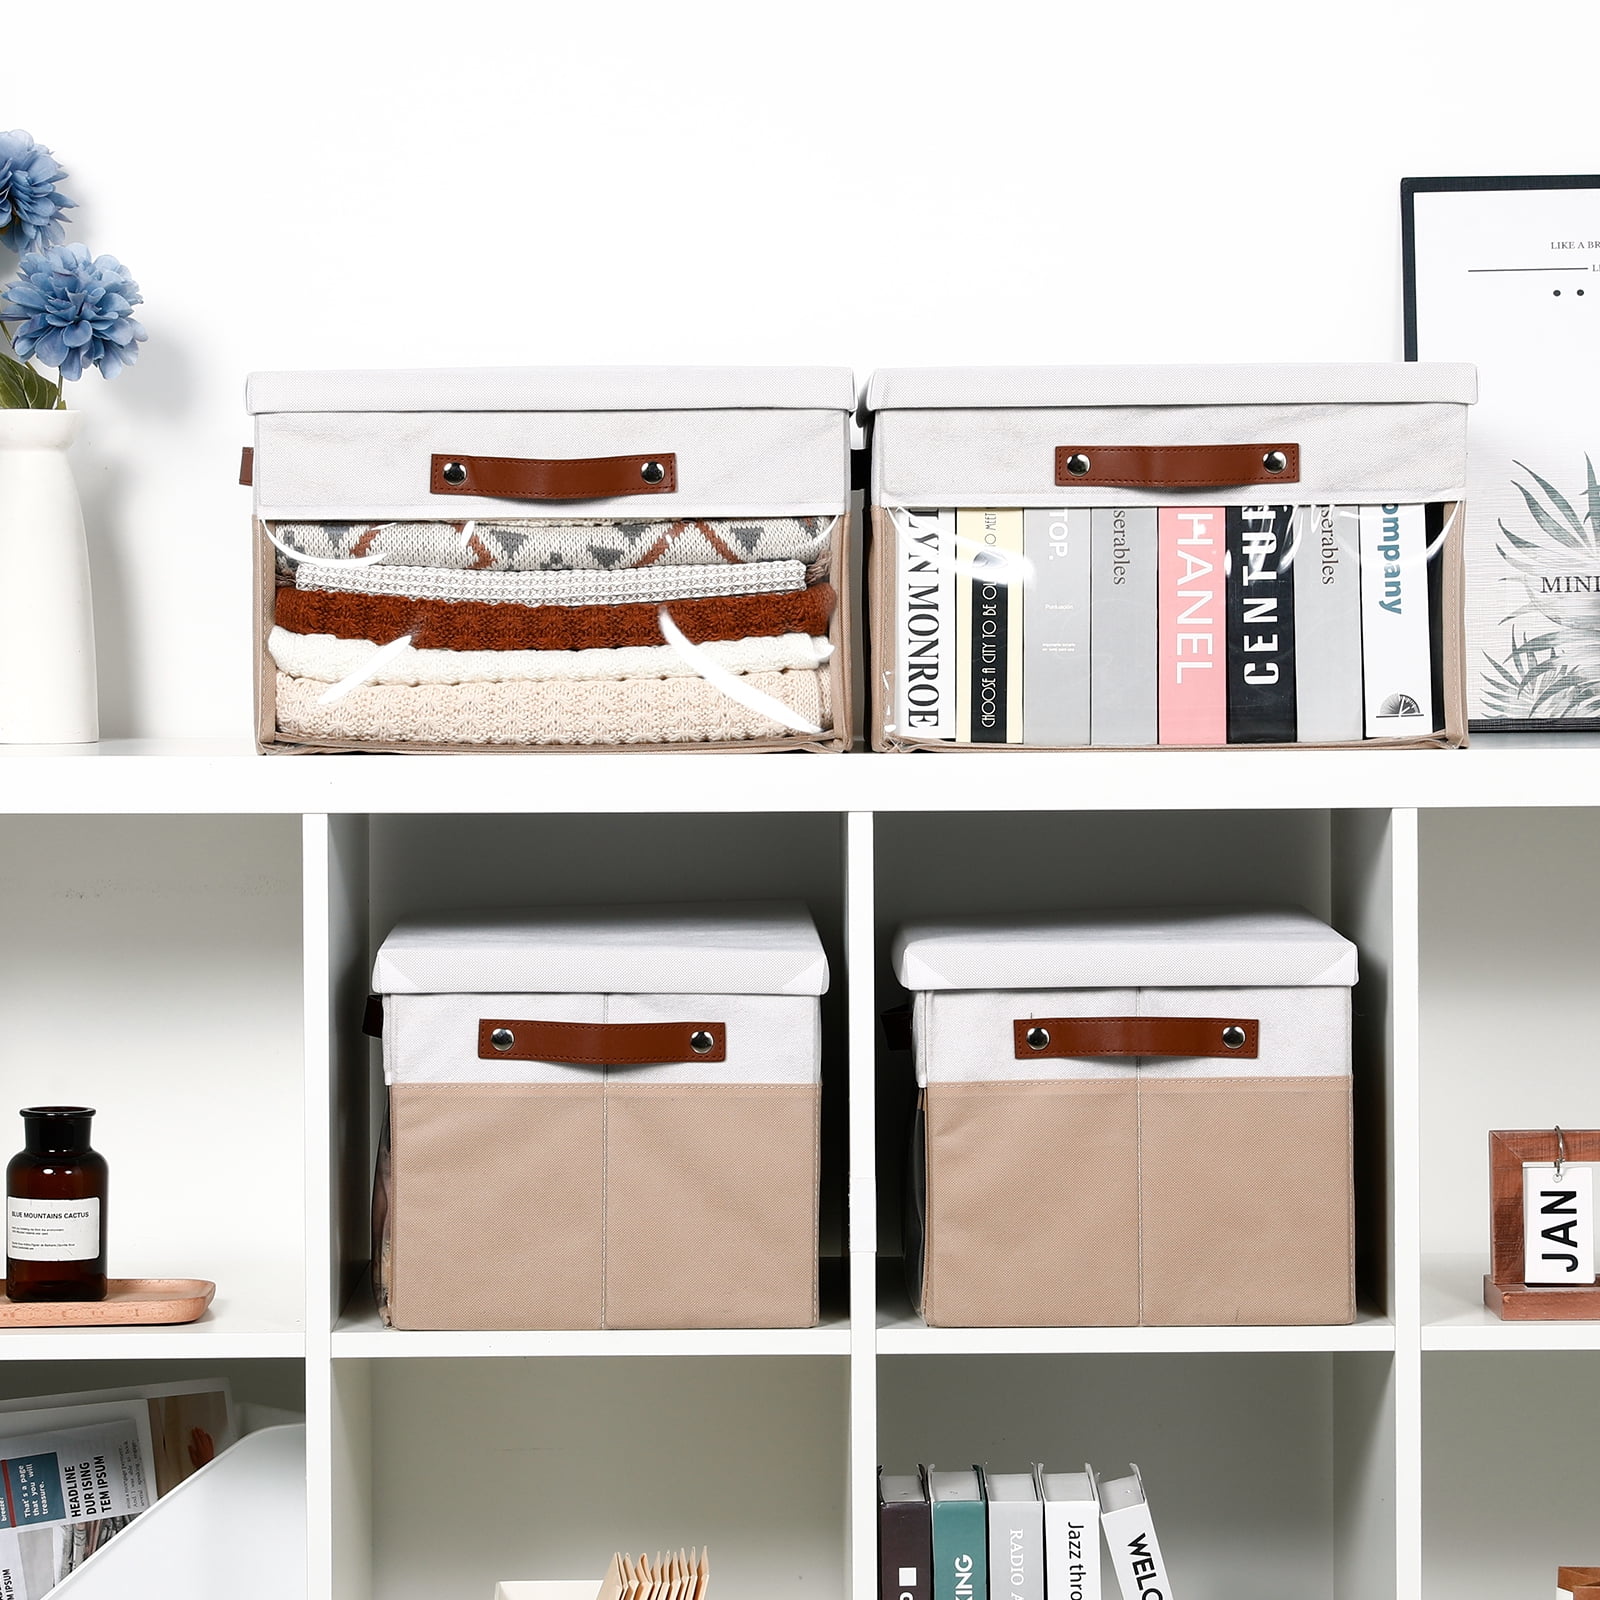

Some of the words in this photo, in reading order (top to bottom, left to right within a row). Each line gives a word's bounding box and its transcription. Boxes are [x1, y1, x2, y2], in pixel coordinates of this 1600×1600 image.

[1551, 241, 1576, 250] LIKE
[1577, 241, 1585, 249] A
[1048, 508, 1068, 560] TOP.
[1112, 510, 1131, 585] serables
[1320, 507, 1339, 585] serables
[982, 604, 997, 616] BE
[1176, 513, 1214, 684] HANEL
[982, 620, 997, 638] TO
[907, 583, 940, 728] MONROE
[982, 642, 997, 663] CITY
[981, 678, 996, 728] CHOOSE
[64, 1211, 89, 1219] CACTUS
[1540, 1191, 1579, 1272] JAN
[19, 1465, 27, 1483] page
[26, 1464, 34, 1478] will
[79, 1462, 93, 1491] ISING
[94, 1455, 108, 1489] IPSUM
[30, 1482, 38, 1496] you
[39, 1481, 49, 1515] treasure.
[64, 1465, 81, 1518] HEADLINE
[84, 1492, 97, 1515] DUR
[99, 1490, 112, 1513] TEM
[32, 1500, 40, 1516] that
[1068, 1521, 1084, 1559] Jazz
[1008, 1528, 1025, 1586] RADIO
[2, 1568, 14, 1593] IPSUM
